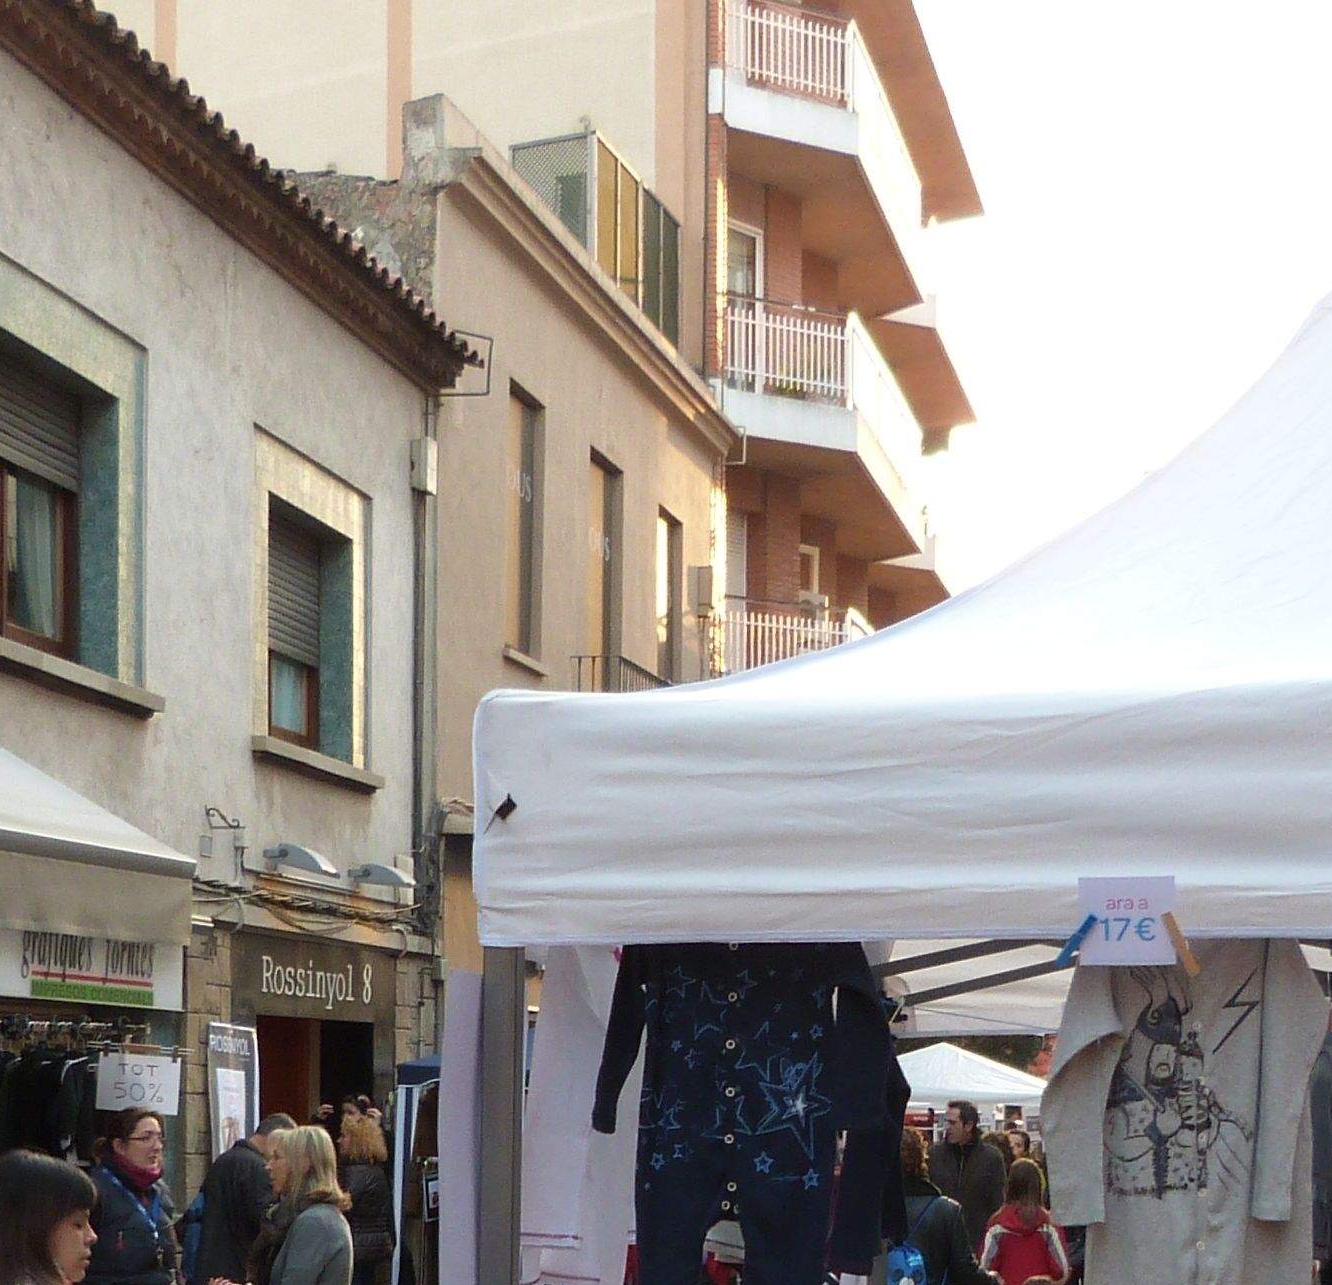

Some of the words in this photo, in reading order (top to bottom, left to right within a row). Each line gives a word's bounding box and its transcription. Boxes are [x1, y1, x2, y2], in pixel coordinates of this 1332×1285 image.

[1105, 898, 1134, 911] ara
[1138, 899, 1149, 911] a
[1099, 917, 1156, 942] 17€
[261, 956, 355, 1010] Rossinyol
[362, 963, 373, 1004] 8
[118, 1062, 159, 1077] TOT
[113, 1081, 165, 1103] 50%
